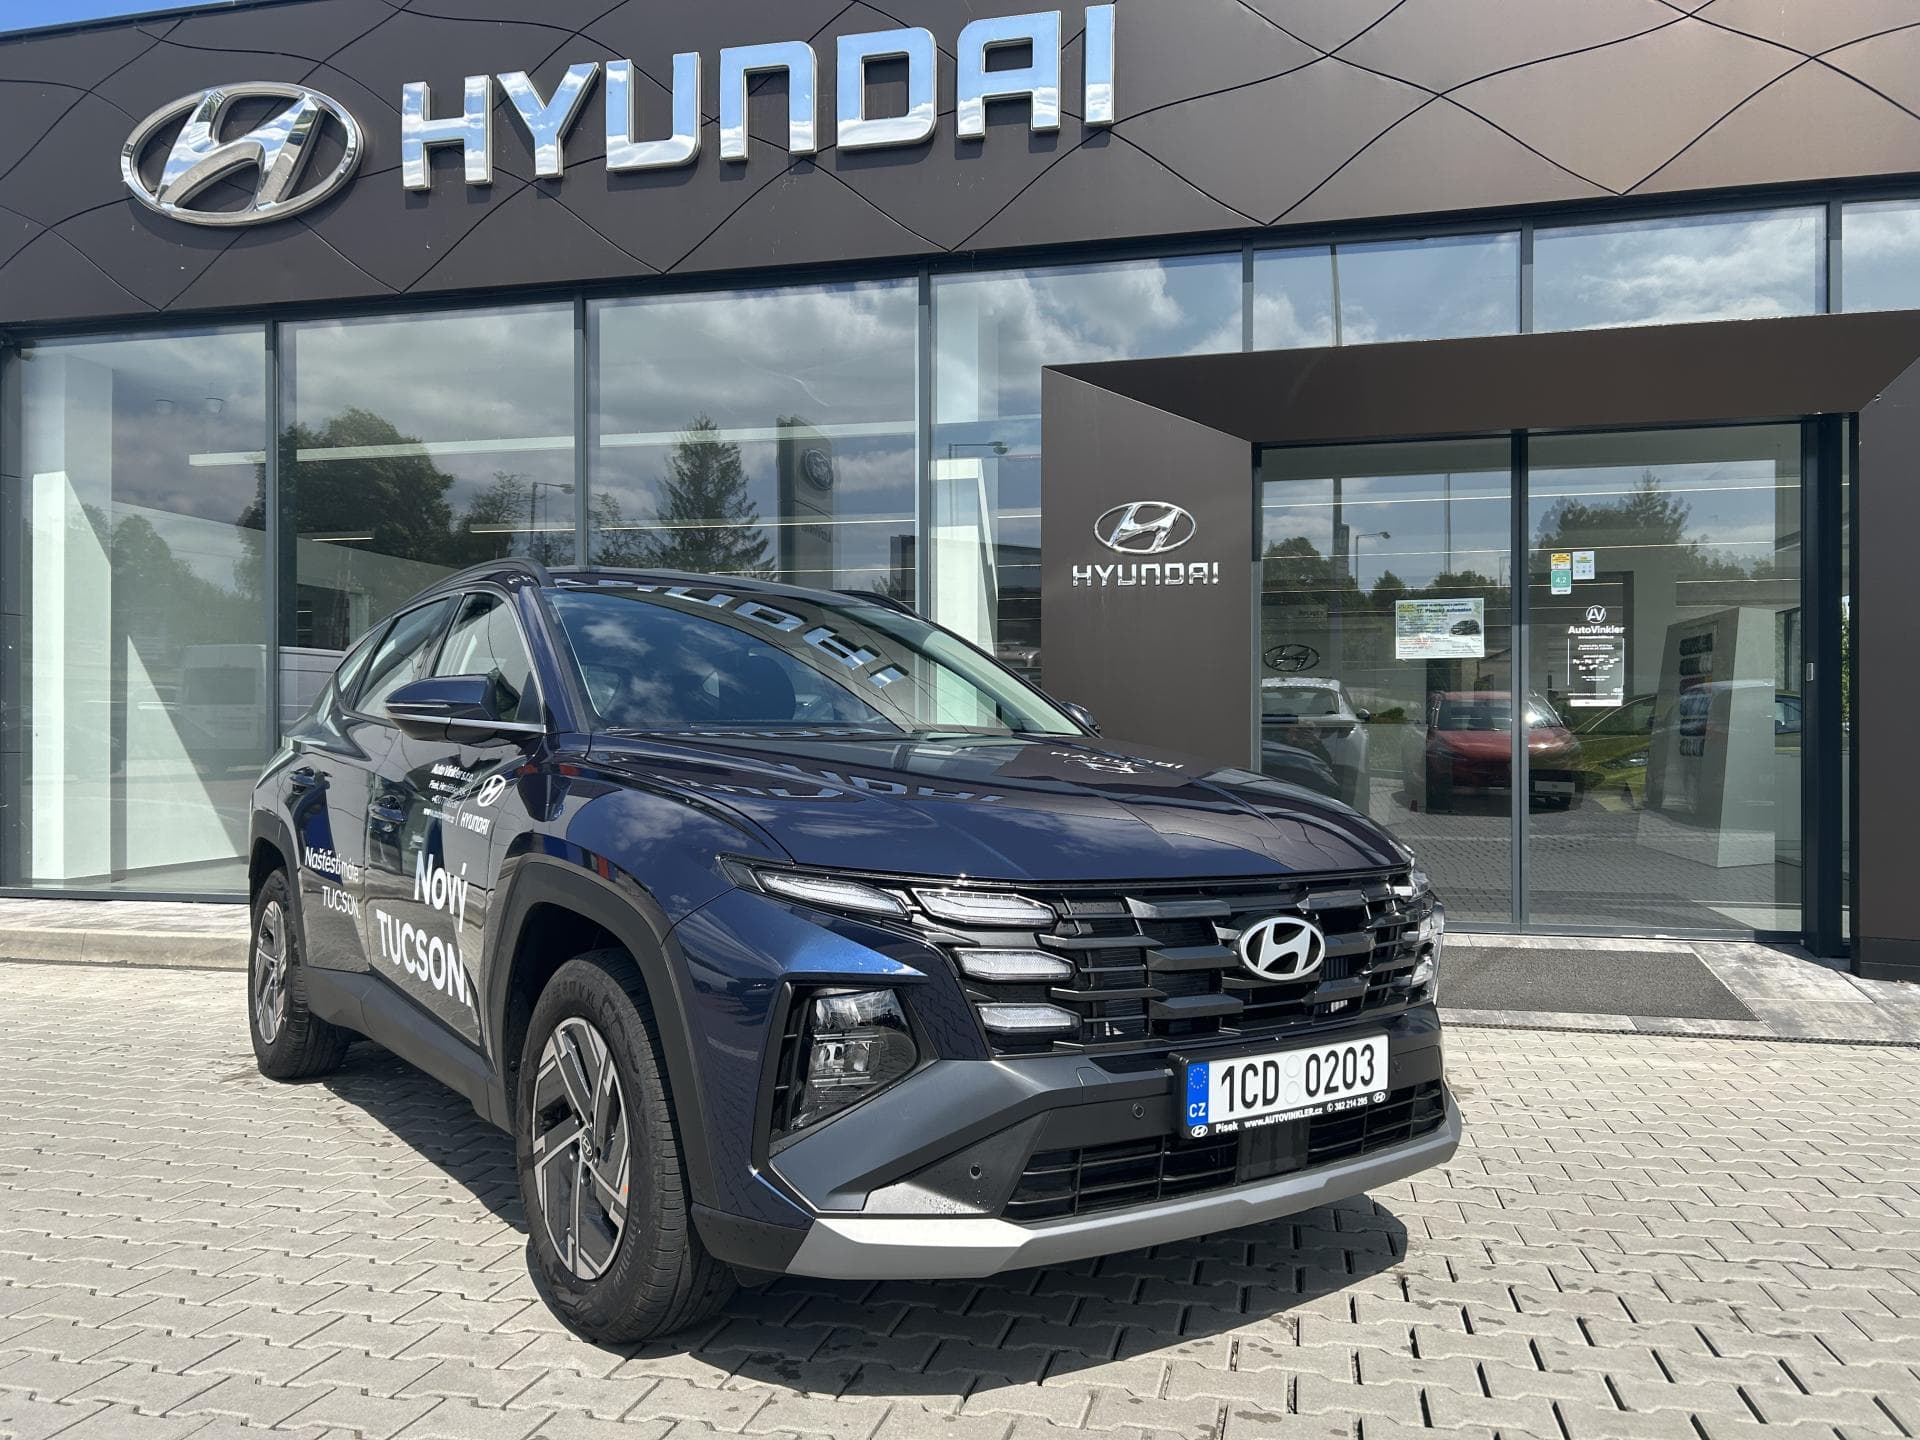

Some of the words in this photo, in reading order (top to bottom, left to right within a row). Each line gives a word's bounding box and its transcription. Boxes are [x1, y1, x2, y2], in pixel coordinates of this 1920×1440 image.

[401, 4, 1116, 192] HYUNDAI
[1072, 562, 1219, 588] HYUNDAI
[1567, 625, 1625, 634] AutoVinkler
[460, 811, 491, 836] HYUNDAI
[414, 850, 468, 933] Nový
[1220, 1059, 1280, 1113] 1CD
[1304, 1043, 1375, 1098] 0203
[1189, 1102, 1206, 1118] CZ
